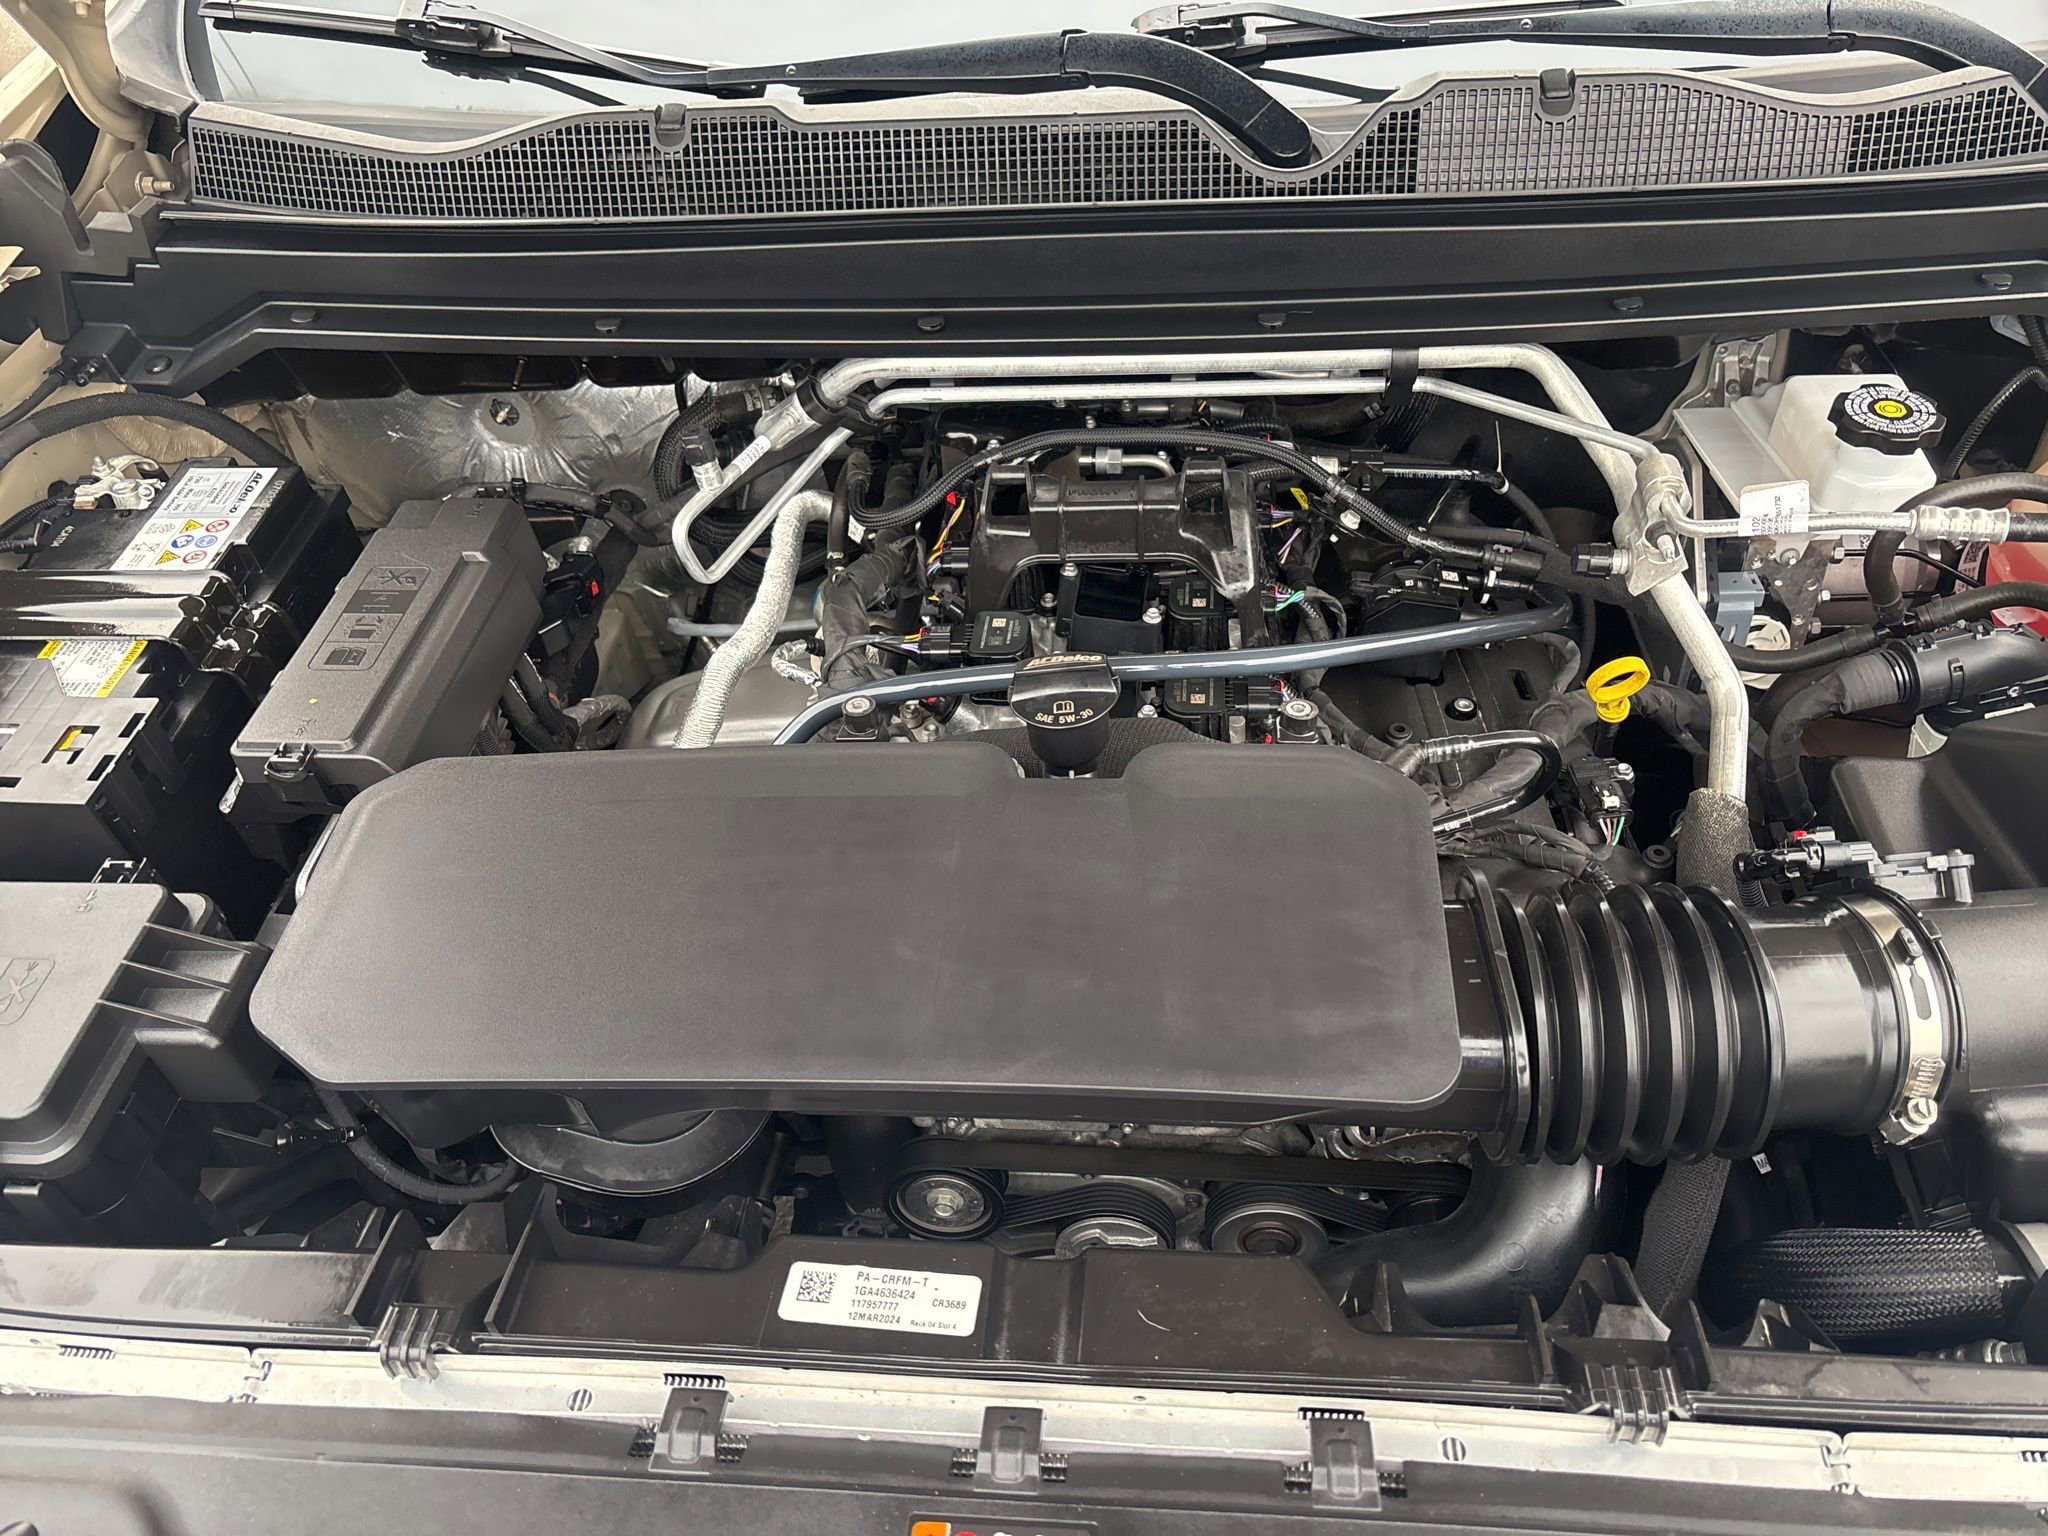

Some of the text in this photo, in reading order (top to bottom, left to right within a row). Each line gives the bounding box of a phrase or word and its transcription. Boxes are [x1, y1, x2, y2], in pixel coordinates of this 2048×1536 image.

[229, 472, 263, 513] ACDelco
[1025, 654, 1102, 668] ACDelco
[1035, 708, 1094, 724] SAE 5W-30
[857, 1272, 928, 1287] PA-CRFM-T
[854, 1286, 916, 1300] 1GA4636424
[852, 1300, 899, 1311] 117957777
[932, 1298, 966, 1310] CR3689
[848, 1312, 900, 1324] 12MAR2024
